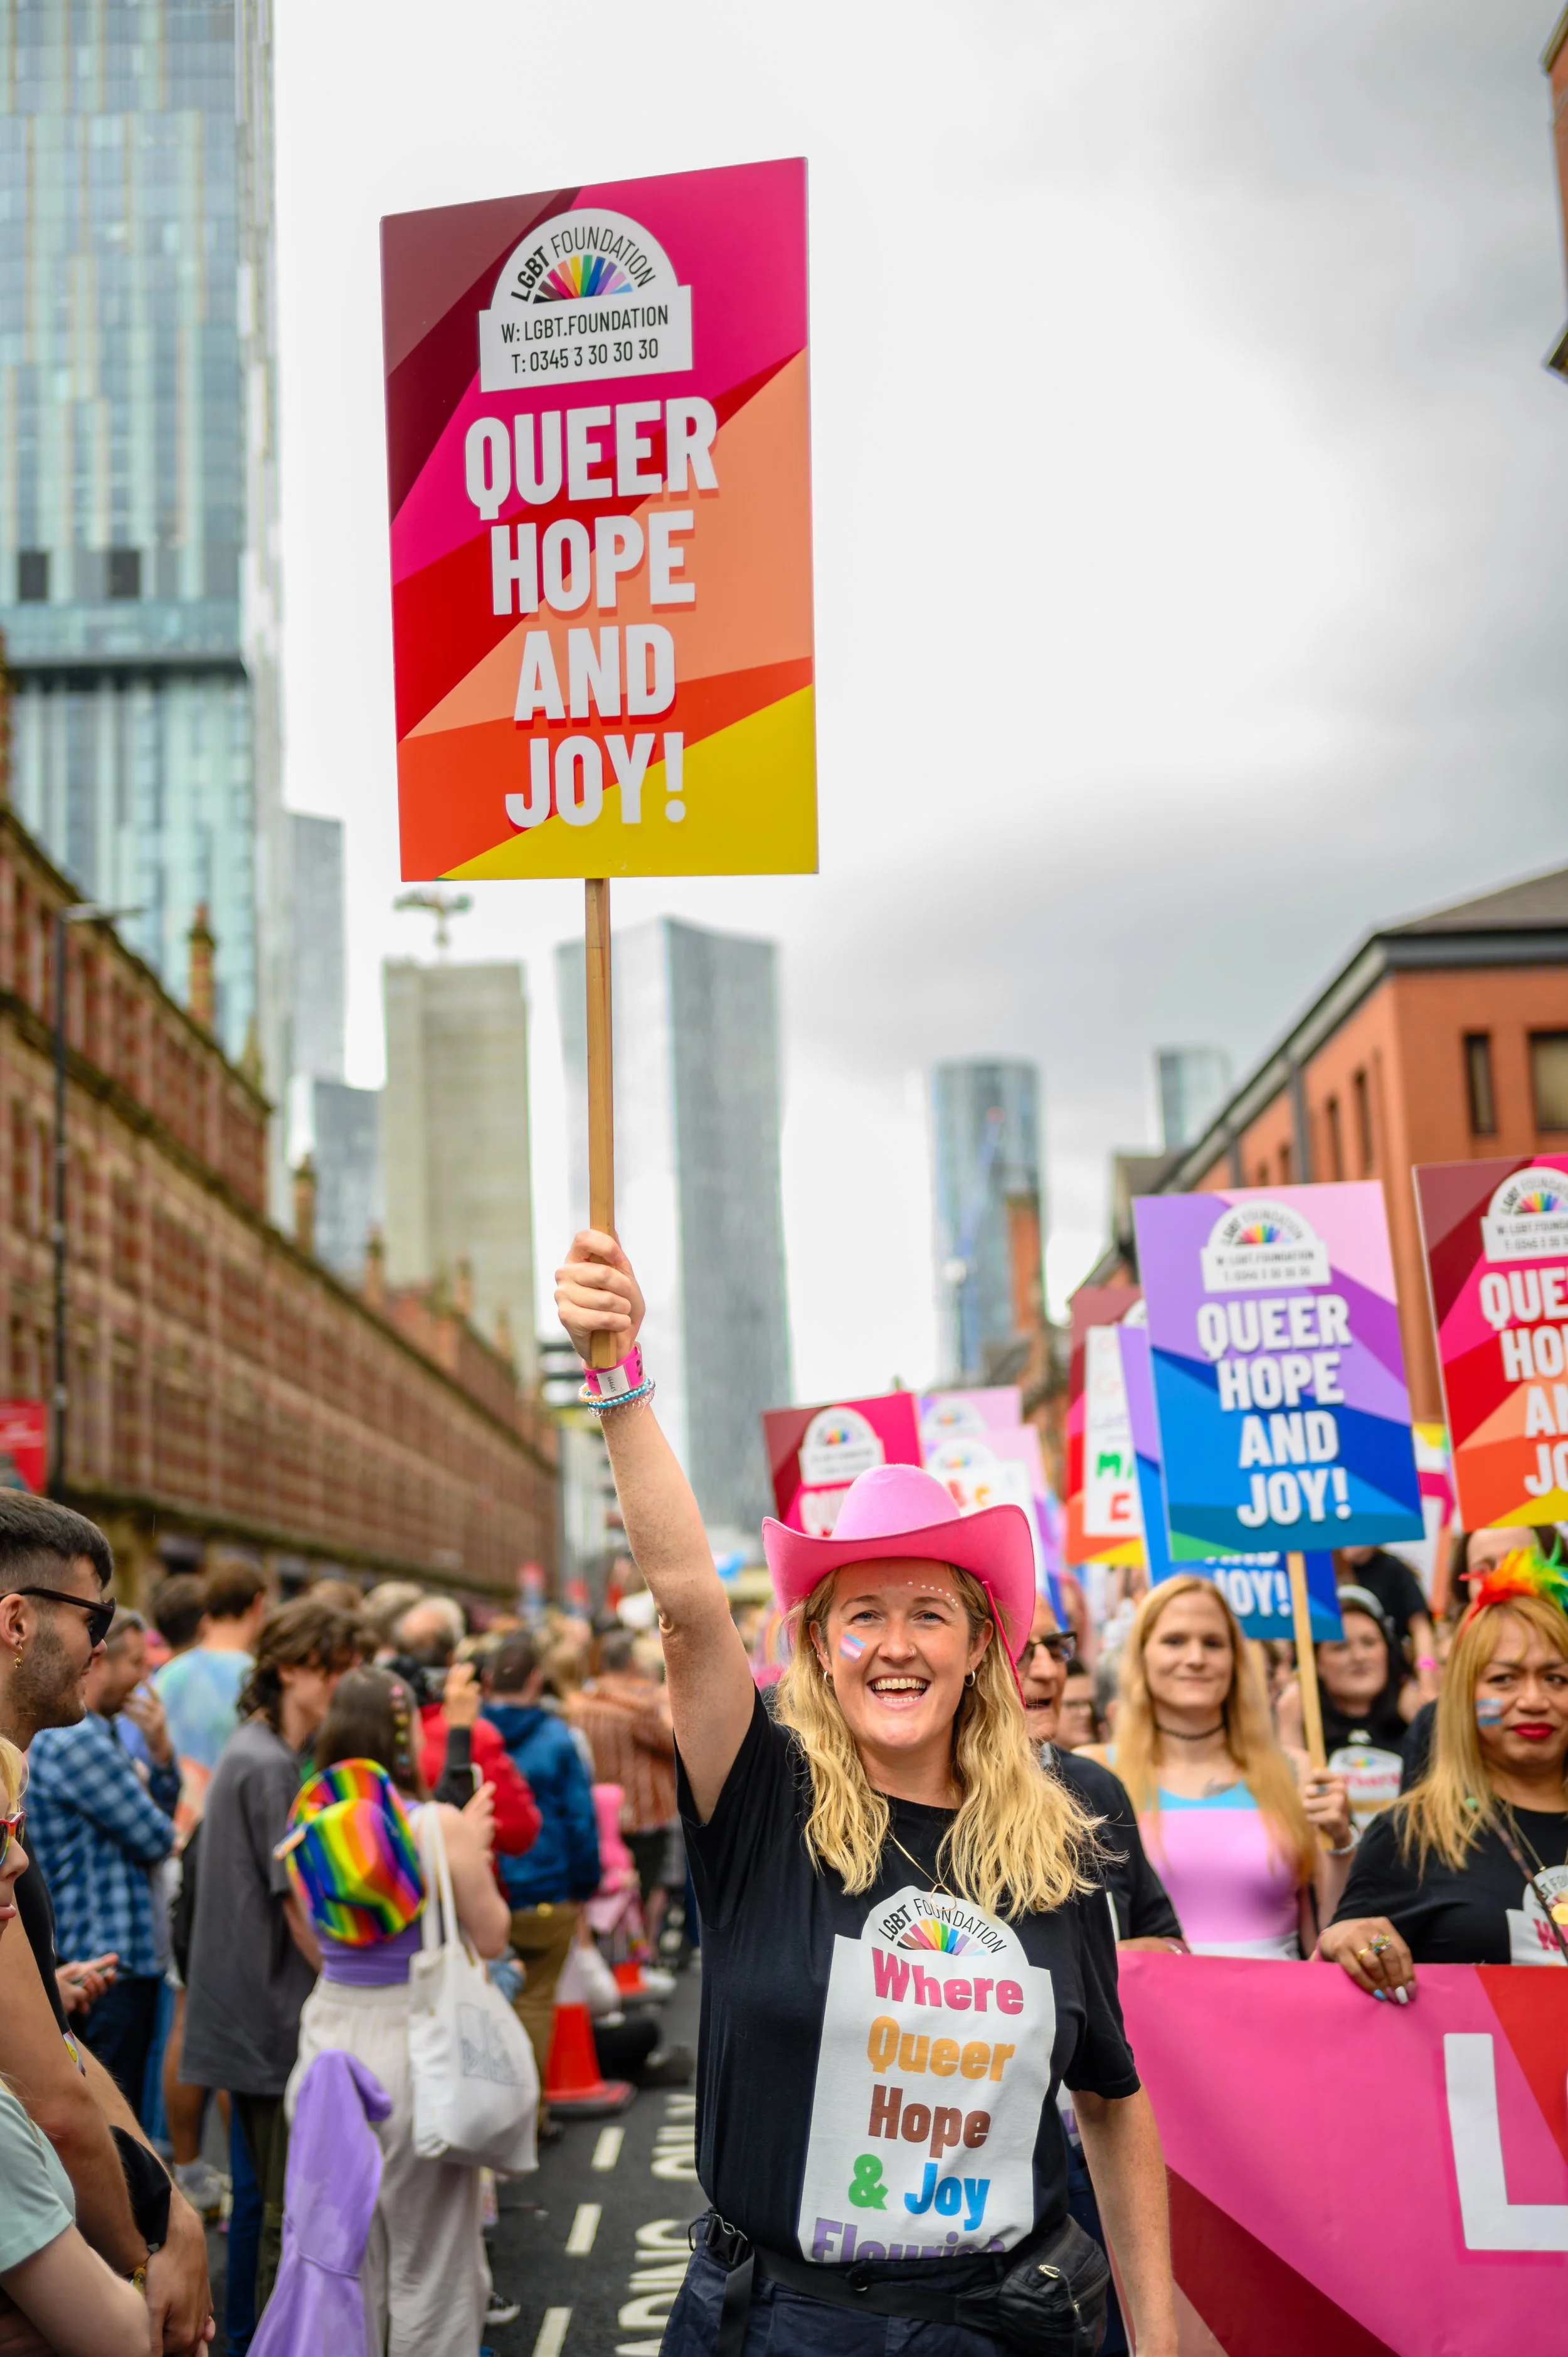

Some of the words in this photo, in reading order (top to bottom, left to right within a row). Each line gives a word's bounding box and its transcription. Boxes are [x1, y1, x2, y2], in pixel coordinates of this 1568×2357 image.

[511, 245, 549, 302] LGBT
[551, 226, 656, 288] FOUNDATION
[501, 323, 520, 343] W:
[524, 305, 668, 341] LGBT.FOUNDATION
[512, 354, 526, 373] T:
[530, 348, 568, 371] 0345
[574, 347, 583, 367] 3
[588, 344, 607, 364] 30
[613, 341, 632, 362] 30
[638, 338, 658, 359] 30
[465, 396, 719, 520] QUEER
[490, 509, 696, 615] HOPE
[514, 624, 675, 721] AND
[505, 732, 687, 827] JOY!
[1196, 1294, 1352, 1359] QUEER
[1479, 1267, 1568, 1331] QUE
[1216, 1351, 1345, 1412] HOPE
[1239, 1410, 1340, 1468] AND
[1236, 1467, 1352, 1528] JOY!
[879, 1904, 912, 1942] LGBT
[913, 1898, 1007, 1953] FOUNDATION
[872, 1947, 1024, 2014] Where
[867, 2016, 1015, 2082] Queer
[867, 2084, 990, 2158] Hope
[848, 2153, 889, 2210] &
[904, 2163, 990, 2231] Joy
